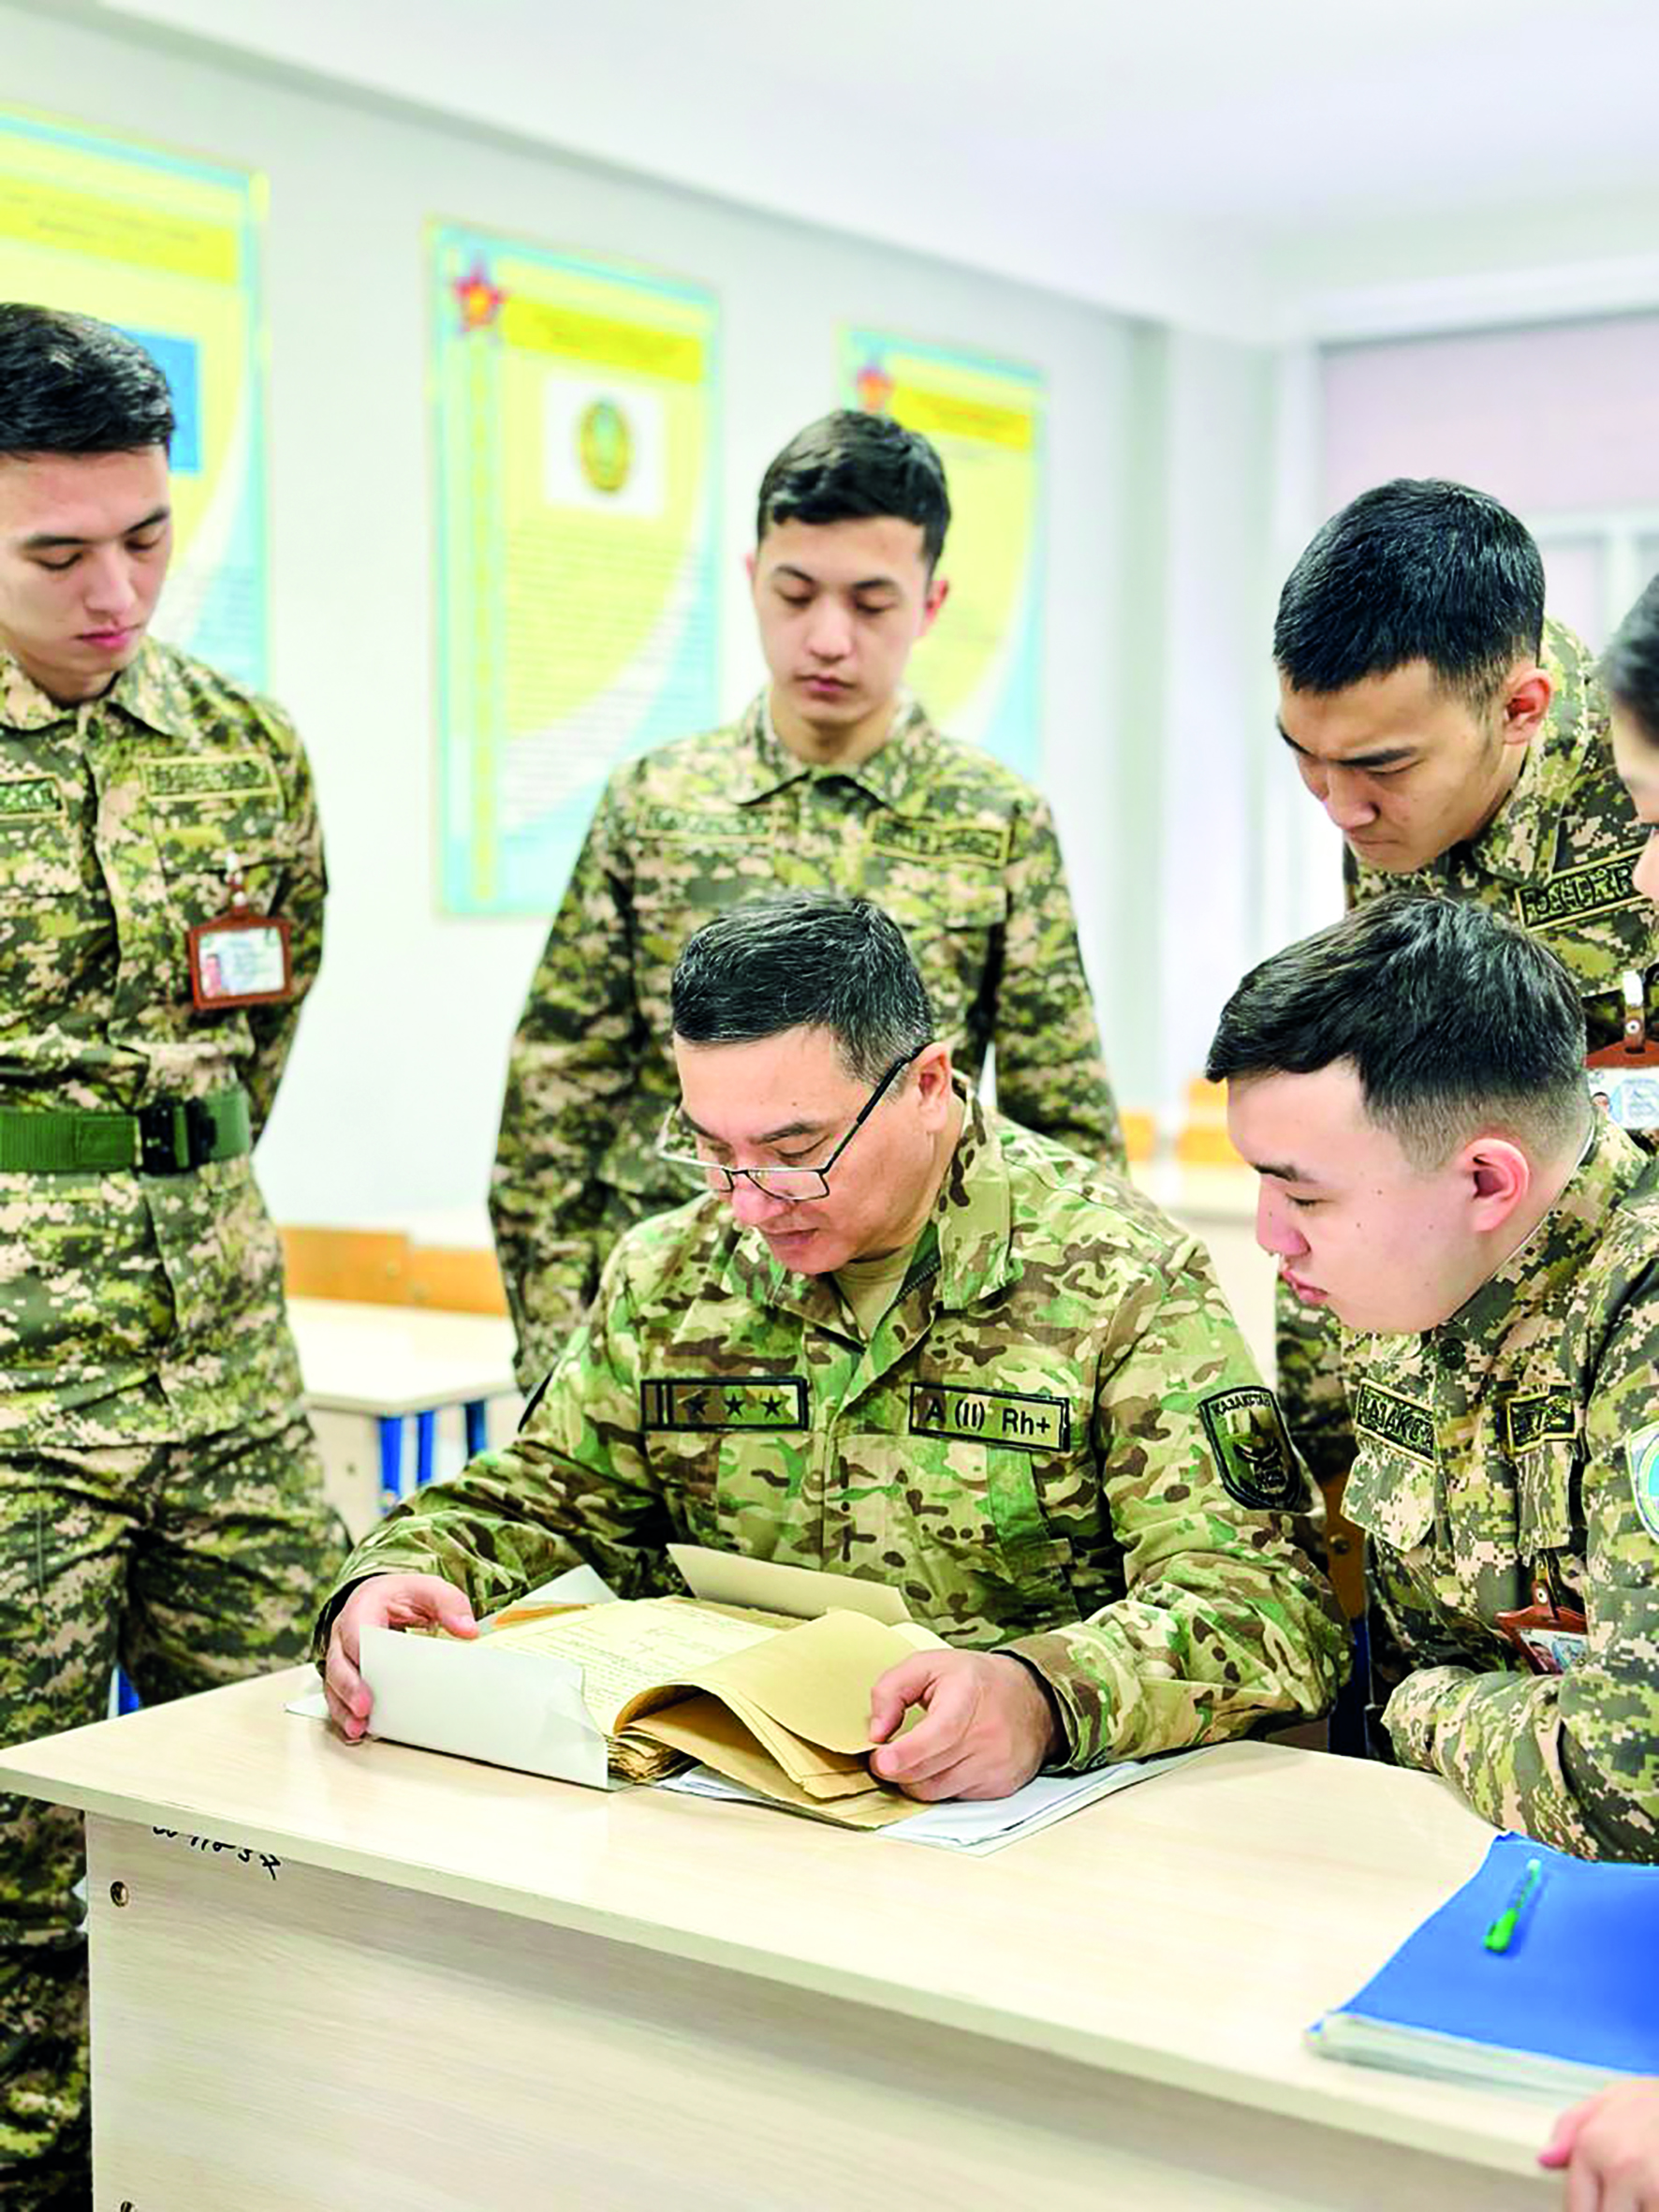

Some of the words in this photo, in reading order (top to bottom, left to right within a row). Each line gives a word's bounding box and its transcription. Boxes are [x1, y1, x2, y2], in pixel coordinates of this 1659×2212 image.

[925, 1398, 947, 1423] A
[954, 1398, 985, 1431] (II)
[1002, 1408, 1050, 1436] Rh+
